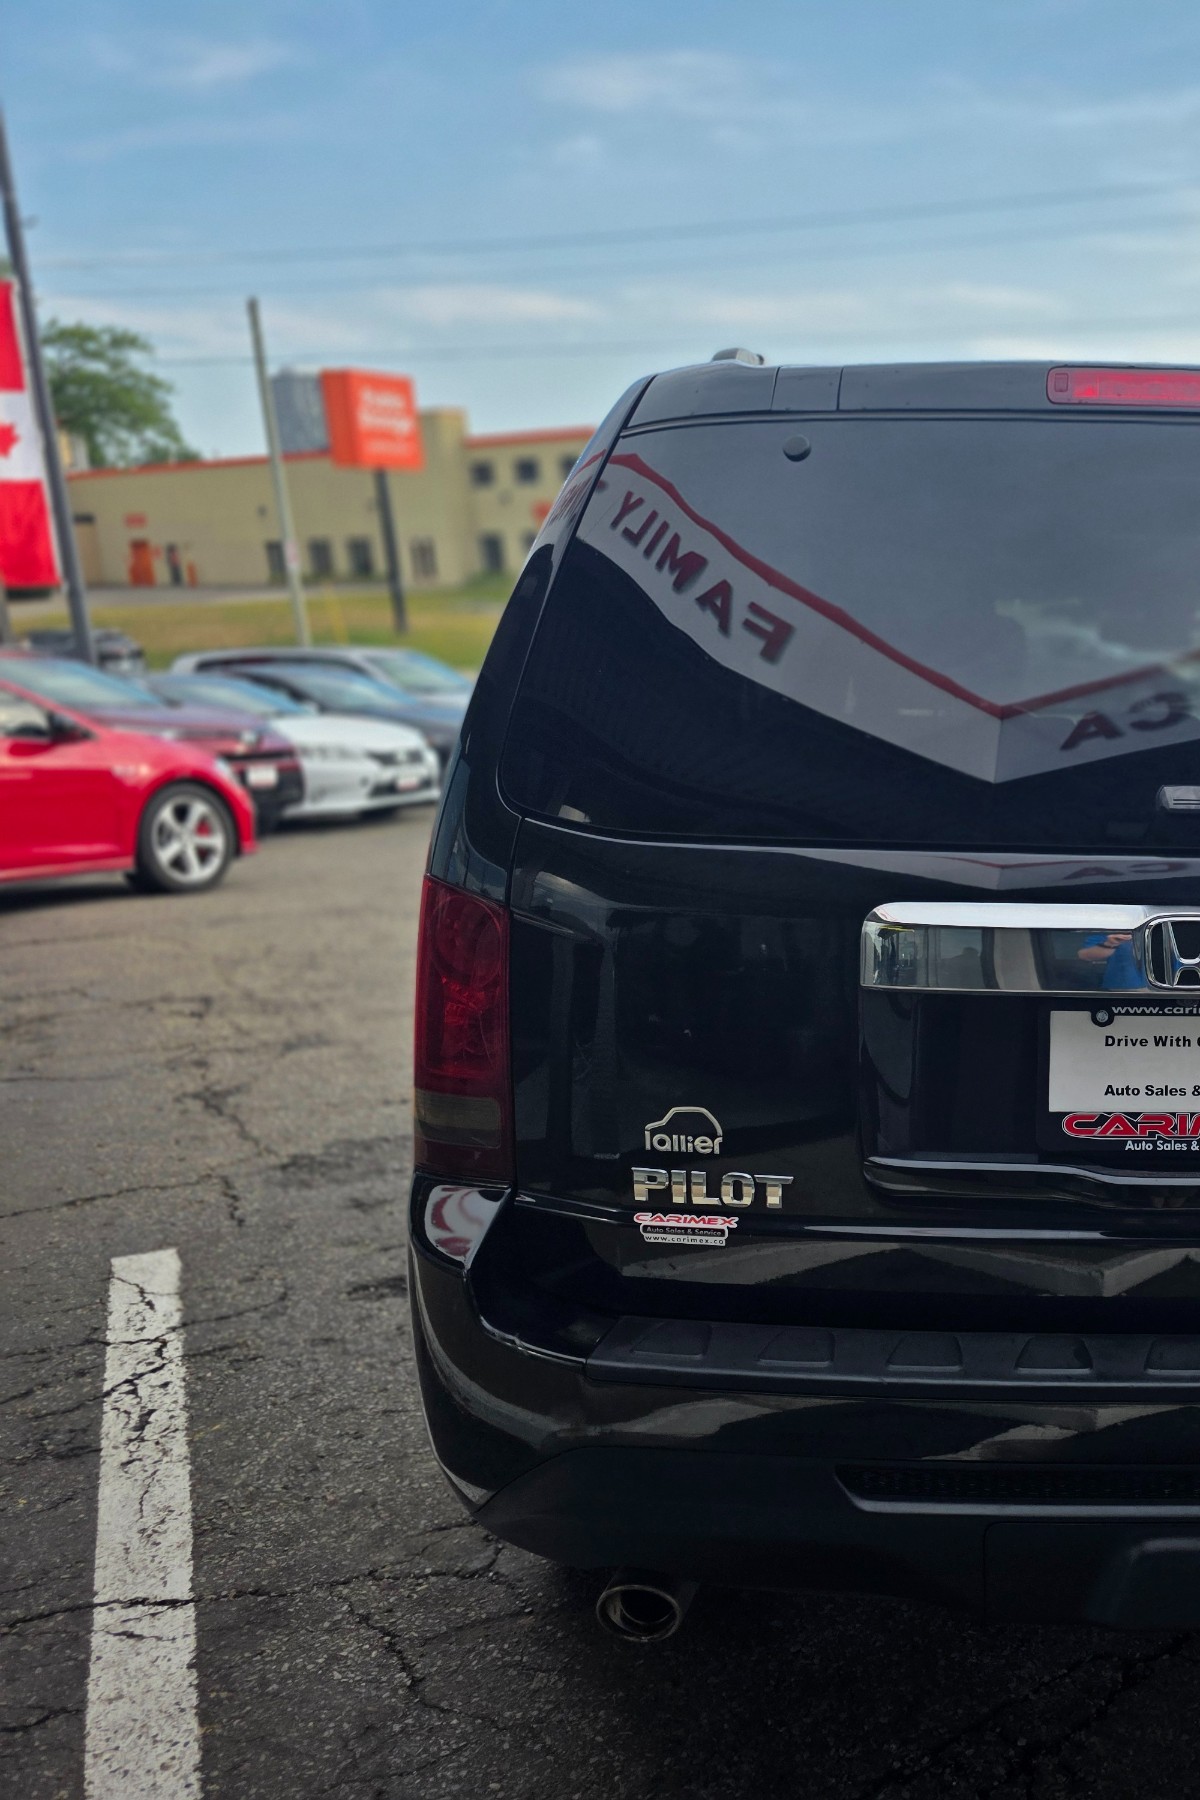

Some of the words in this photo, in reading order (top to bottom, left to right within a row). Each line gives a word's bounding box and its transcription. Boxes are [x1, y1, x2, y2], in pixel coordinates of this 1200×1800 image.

[1104, 1035, 1149, 1048] Drive
[1153, 1035, 1192, 1048] With
[1104, 1084, 1141, 1097] Auto
[1144, 1084, 1187, 1097] Sales
[1125, 1140, 1154, 1151] Auto
[1157, 1140, 1188, 1151] Sales
[1191, 1141, 1200, 1151] &
[631, 1167, 794, 1209] PILOT
[634, 1213, 738, 1227] CARIMEX
[665, 1227, 685, 1235] Sales
